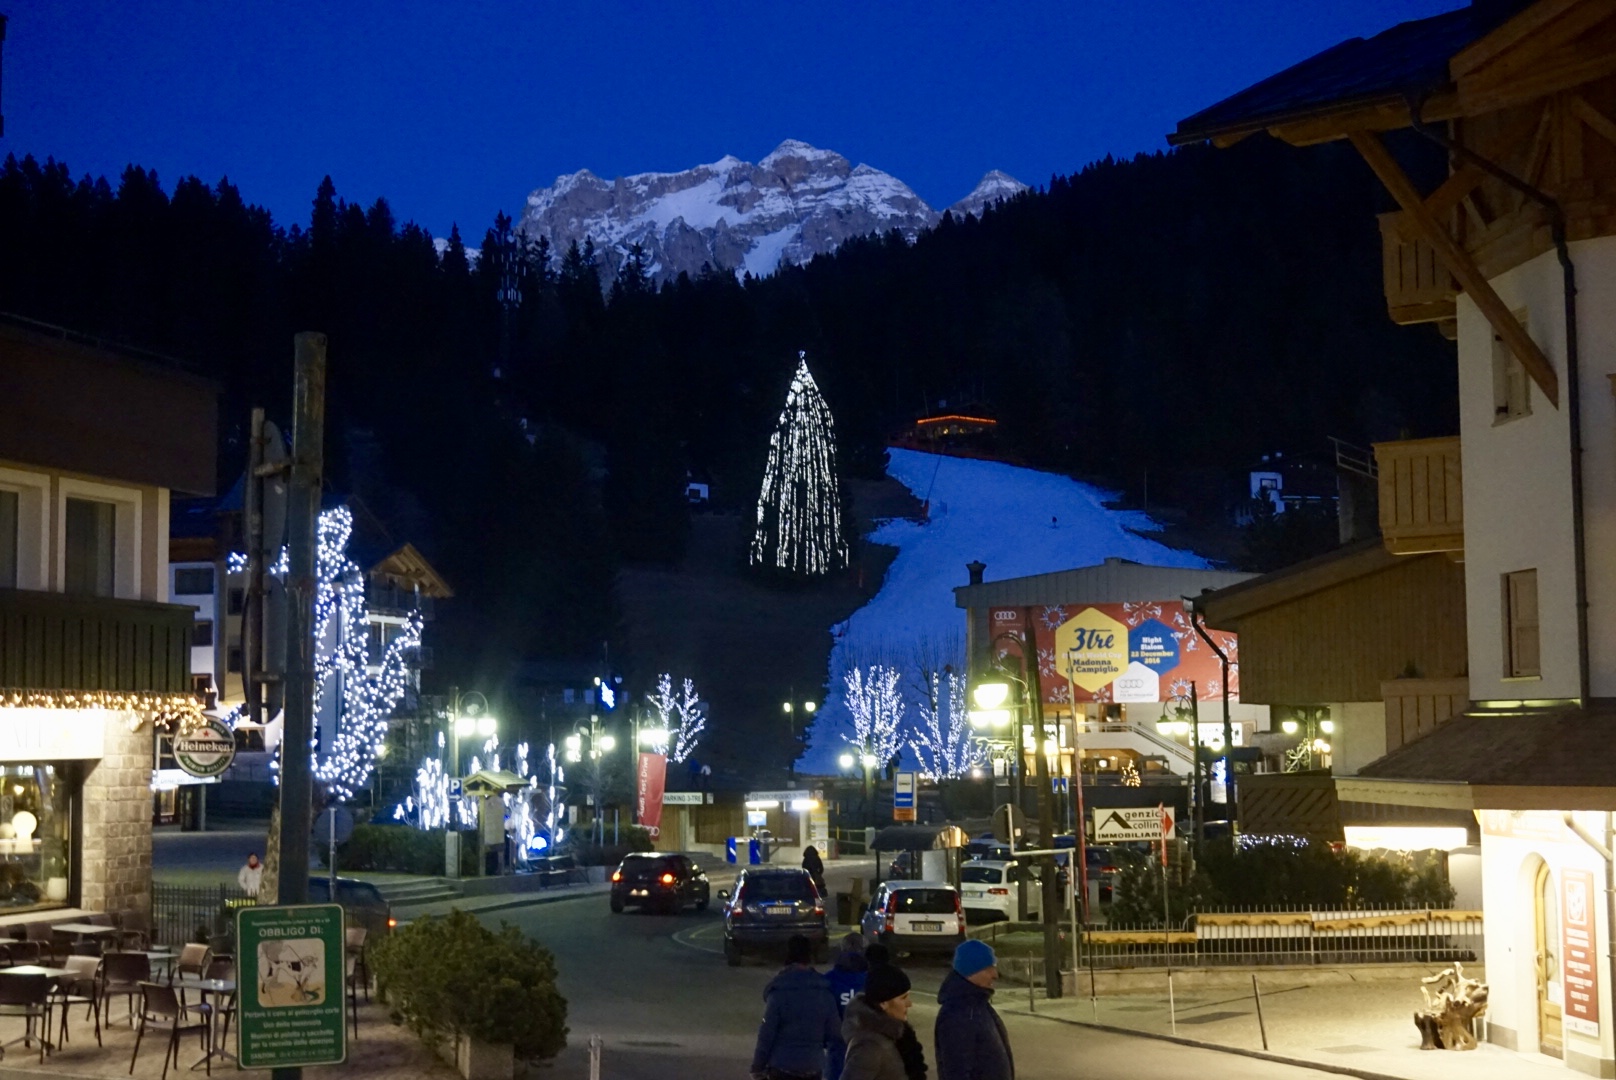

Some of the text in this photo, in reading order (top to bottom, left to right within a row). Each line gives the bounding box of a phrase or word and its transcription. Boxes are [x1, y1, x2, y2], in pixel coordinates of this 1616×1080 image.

[1075, 666, 1119, 674] Campiglio
[180, 740, 231, 752] Heineken
[641, 756, 649, 778] Drive
[450, 780, 460, 793] P
[639, 779, 648, 796] Test
[663, 794, 686, 802] PARKING
[258, 926, 306, 937] OBBLIGO
